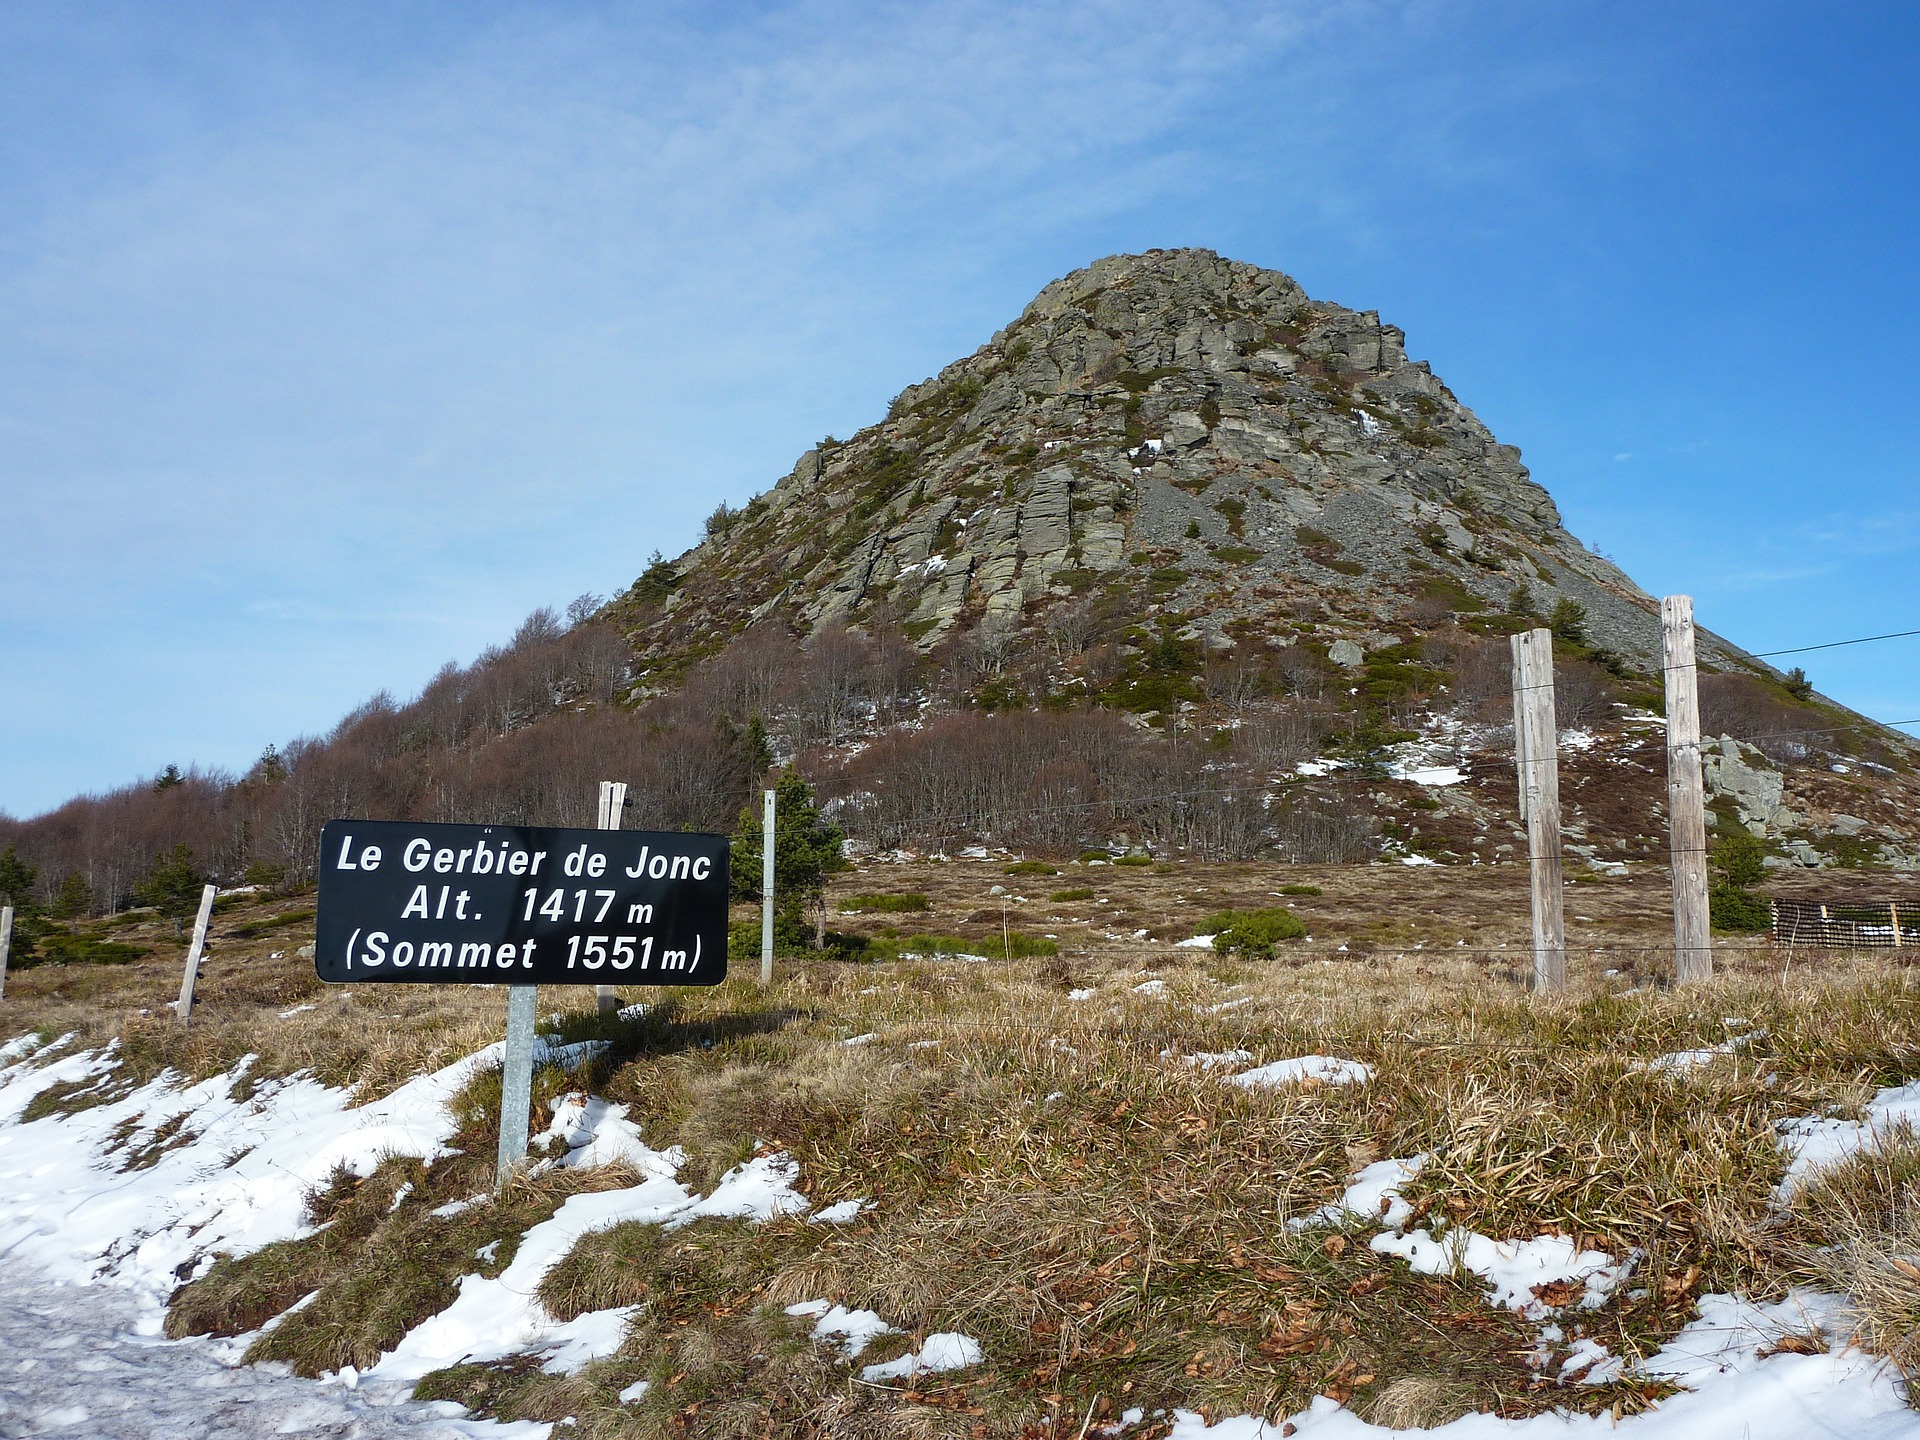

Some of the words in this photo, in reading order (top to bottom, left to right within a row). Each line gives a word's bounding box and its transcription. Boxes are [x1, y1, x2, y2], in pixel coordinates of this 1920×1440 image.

[336, 835, 382, 873] Le
[403, 837, 548, 879] Gerbier
[563, 843, 607, 878] de
[625, 845, 711, 881] Jonc
[400, 884, 482, 920] Alt.
[523, 887, 616, 923] 1417
[627, 904, 653, 924] m
[346, 927, 537, 970] (Sommet
